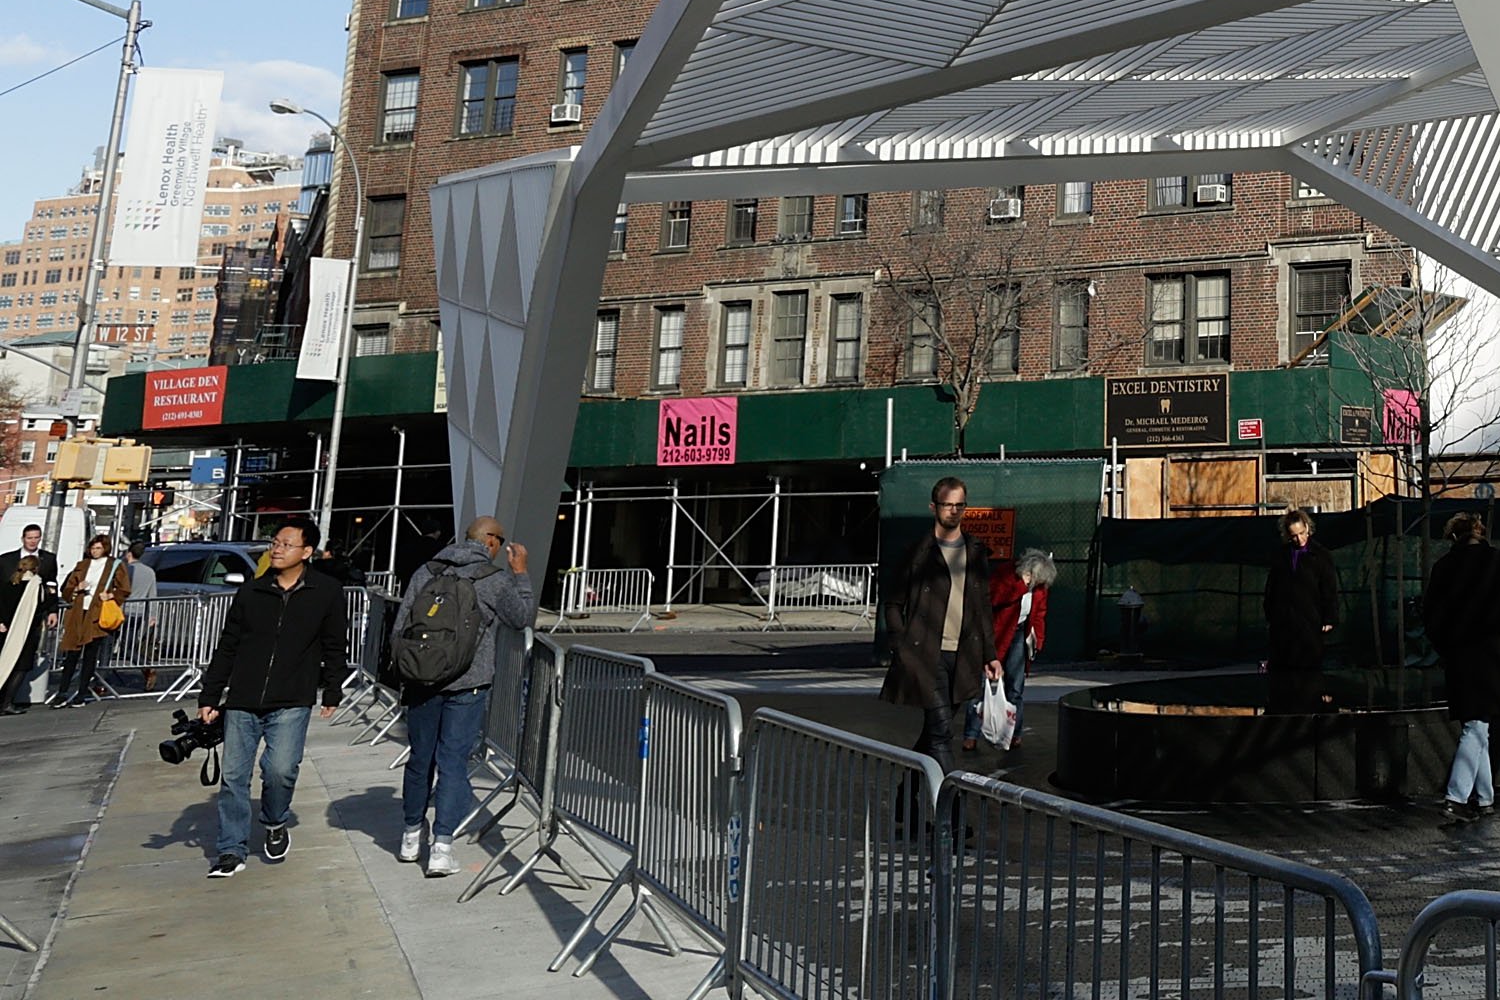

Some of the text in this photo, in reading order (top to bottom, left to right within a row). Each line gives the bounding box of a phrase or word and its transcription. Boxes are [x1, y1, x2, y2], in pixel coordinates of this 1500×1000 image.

[156, 123, 179, 206] Lenox Health
[171, 121, 192, 207] Greenwich Village
[183, 106, 208, 207] Northwell Health
[100, 326, 149, 341] W 12 ST
[153, 375, 219, 391] VILLAGE DEN
[1112, 378, 1221, 395] EXCEL DENTISTRY
[153, 392, 218, 407] RESTAURANT
[1125, 416, 1209, 426] Dr. MICHAEL MEDEIROS
[664, 415, 731, 447] Nails
[1146, 435, 1160, 443] (212)
[662, 447, 730, 463] 212-603-9799
[964, 511, 1003, 520] SIDEWALK
[991, 523, 1007, 533] USE
[729, 818, 741, 898] NYPD
